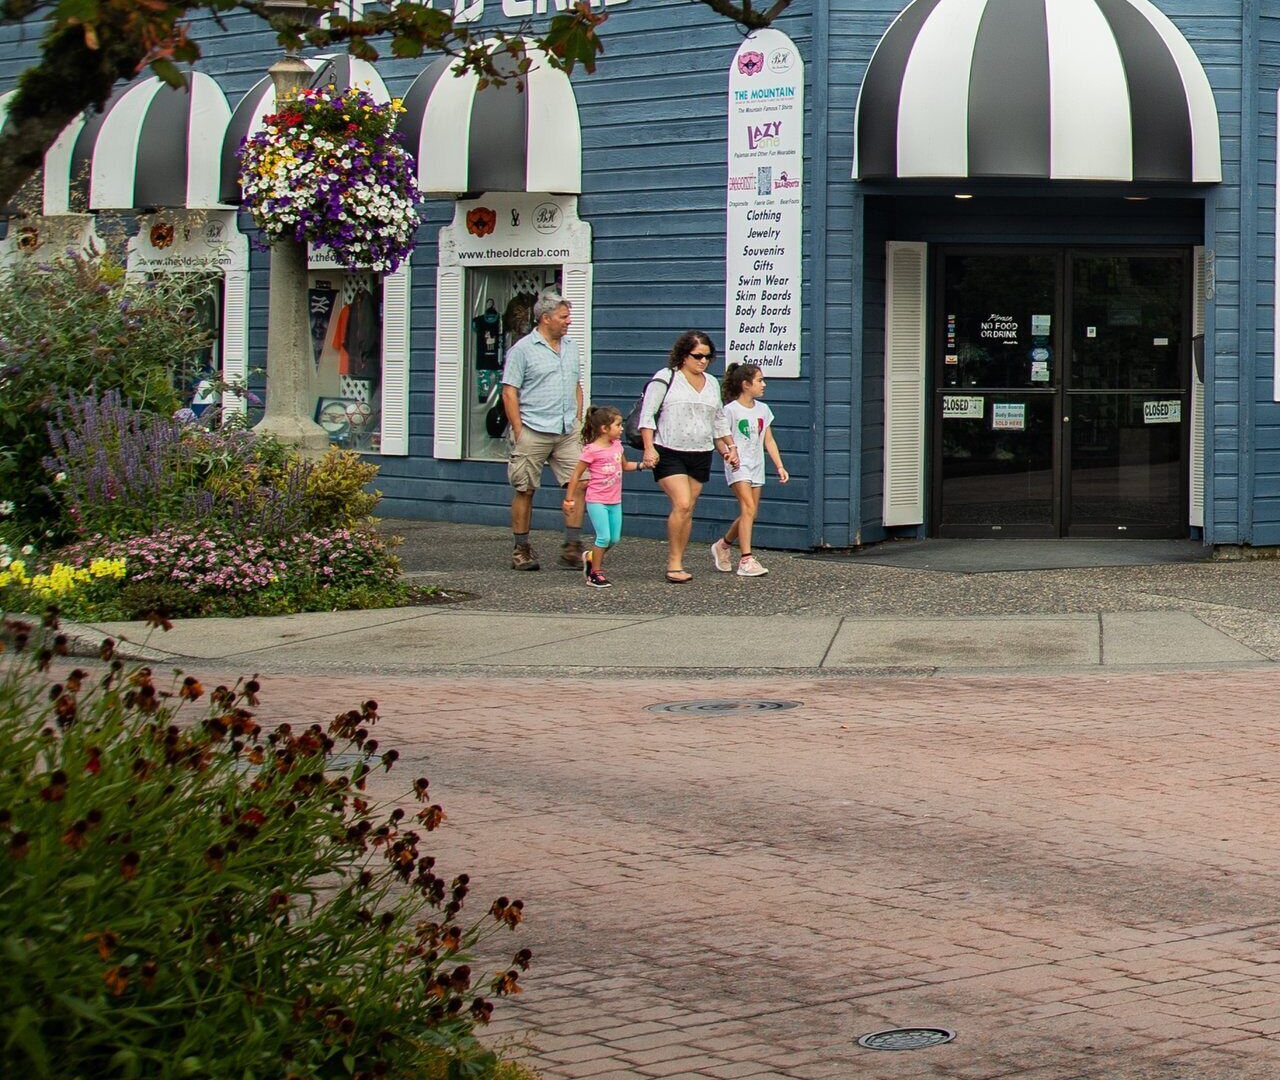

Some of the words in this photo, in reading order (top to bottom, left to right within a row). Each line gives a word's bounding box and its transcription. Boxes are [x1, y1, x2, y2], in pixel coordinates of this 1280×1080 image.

[735, 90, 748, 101] THE
[751, 87, 794, 99] MOUNTAIN
[747, 121, 783, 150] LAZY
[747, 210, 781, 222] Clothing
[747, 227, 781, 240] Jewelry
[458, 248, 570, 259] www.theoldcrab.com
[743, 245, 785, 256] Souvenirs
[753, 260, 774, 271] Gifts
[738, 275, 761, 286] Swim
[765, 275, 789, 286] Wear
[735, 290, 756, 301] Skim
[761, 290, 791, 300] Boards
[735, 305, 757, 318] Body
[761, 305, 791, 315] Boards
[739, 323, 765, 333] Beach
[769, 322, 787, 336] Toys
[981, 322, 993, 330] NO
[995, 322, 1018, 330] FOOD
[981, 330, 993, 338] OR
[993, 330, 1017, 338] DRINK
[729, 340, 755, 351] Beach
[759, 340, 797, 351] Blankets
[943, 399, 969, 411] CLOSED
[1144, 404, 1169, 417] CLOSED
